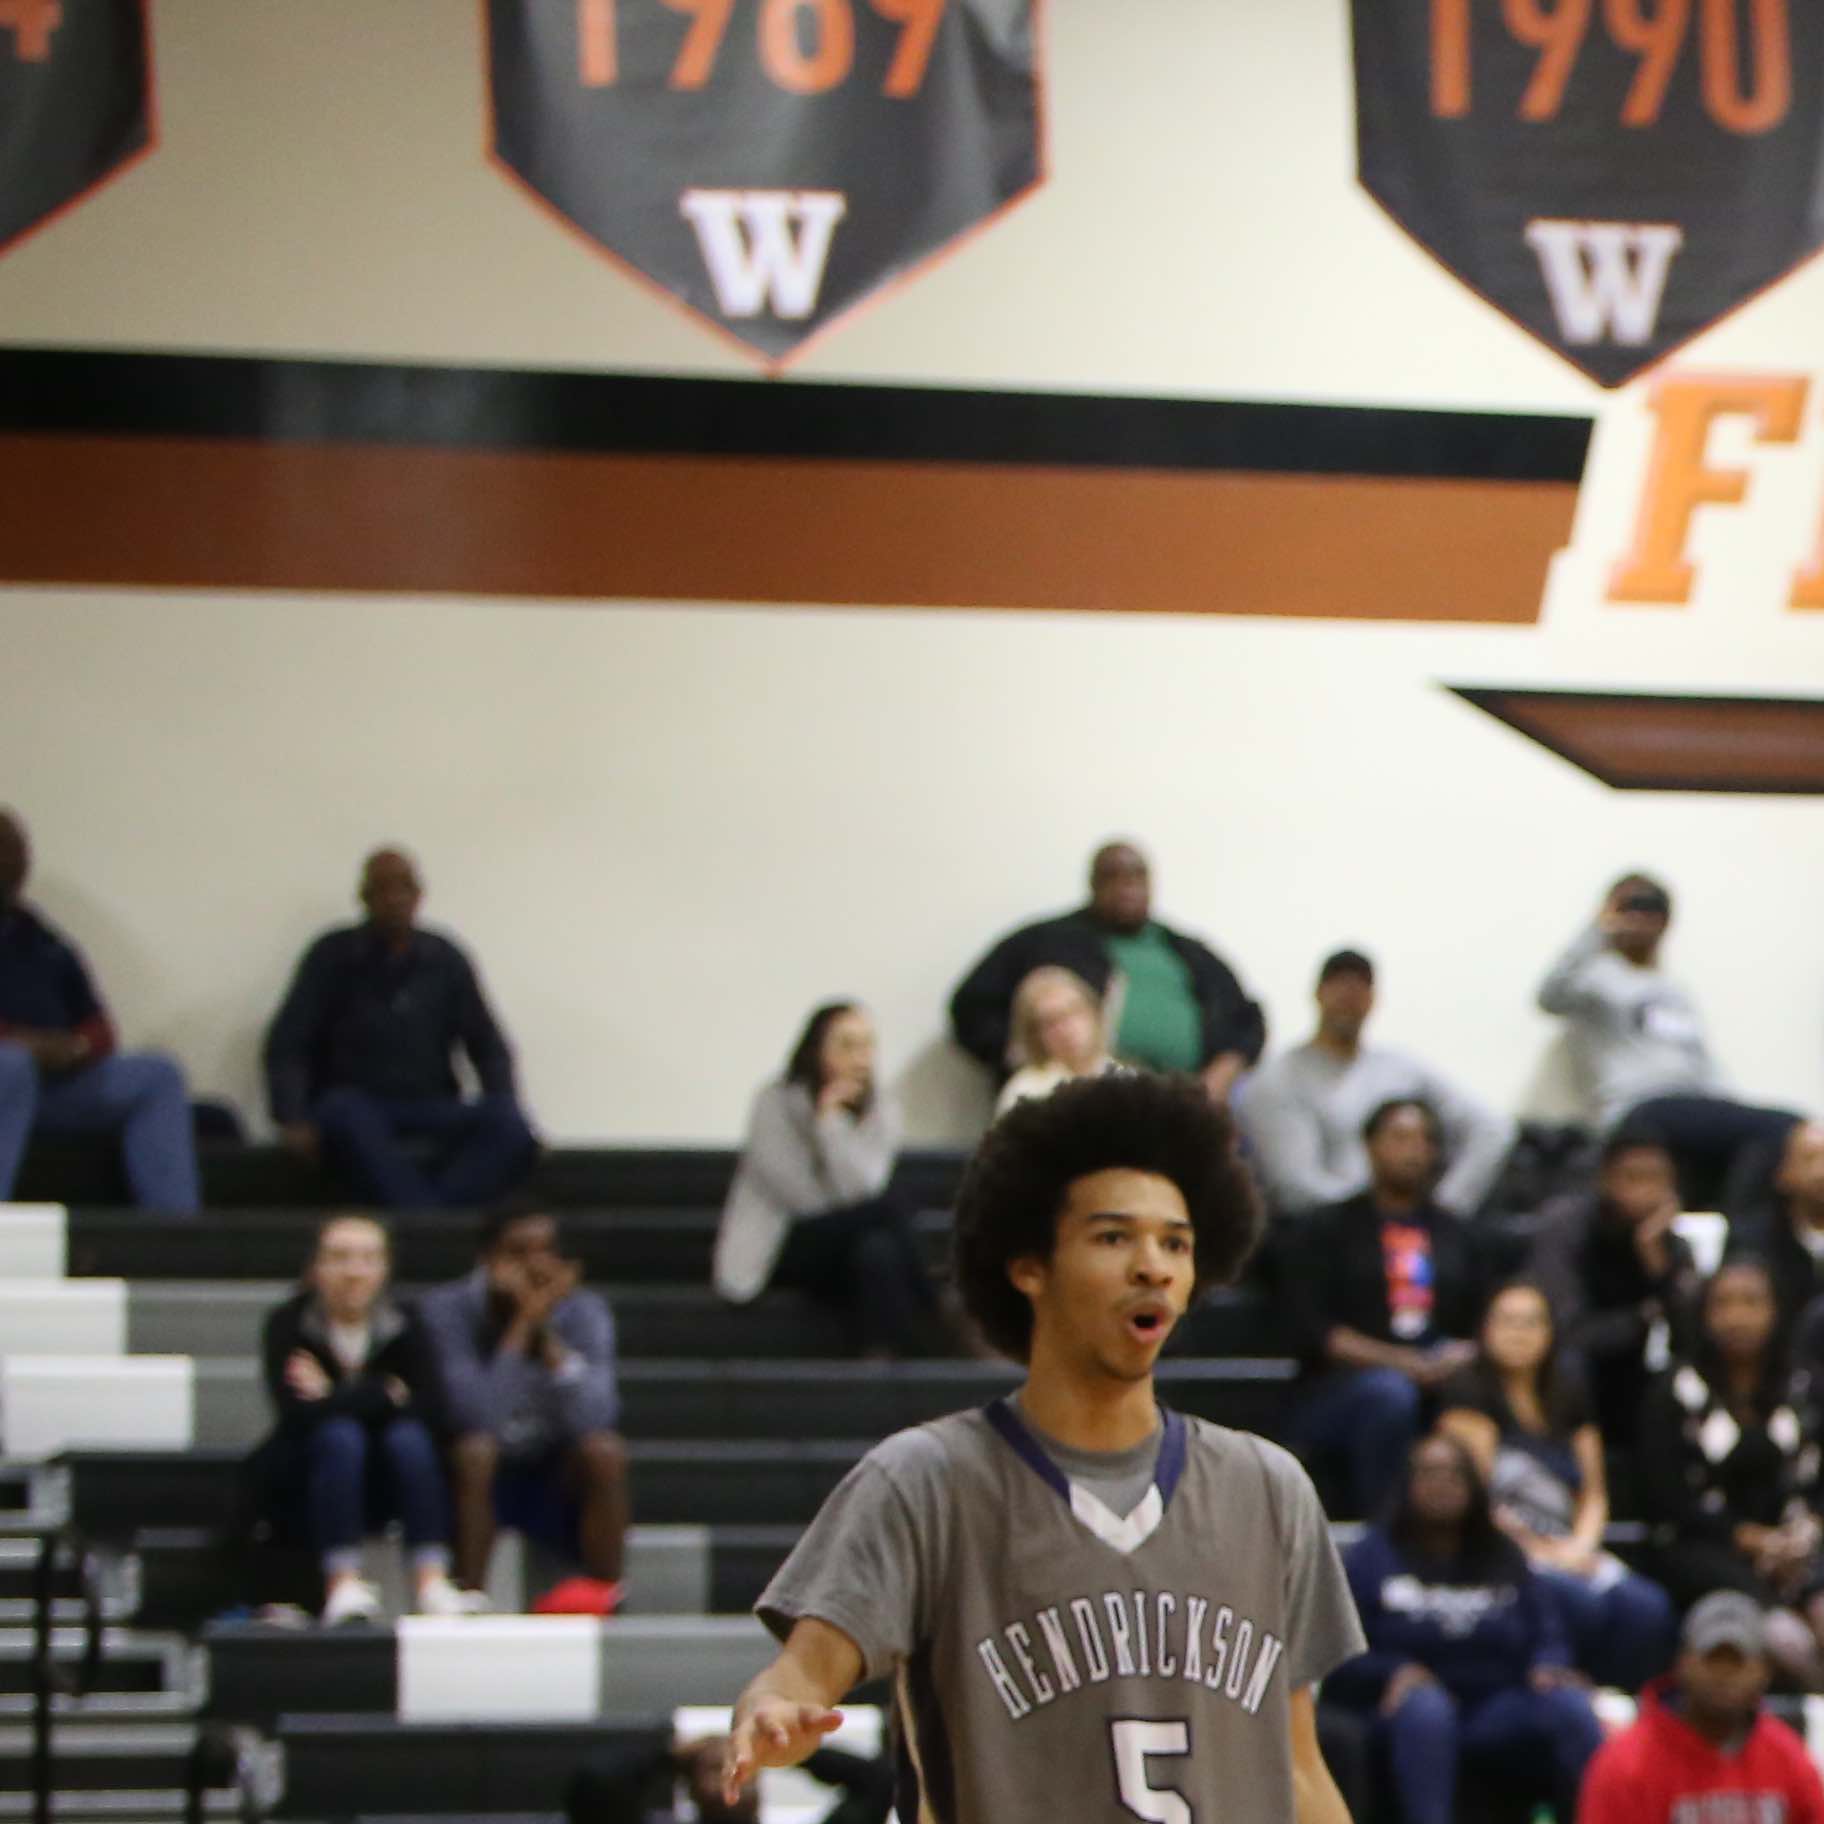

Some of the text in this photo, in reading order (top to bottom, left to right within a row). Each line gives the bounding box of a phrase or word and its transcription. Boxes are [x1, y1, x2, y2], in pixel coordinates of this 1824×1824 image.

[679, 189, 846, 318] W
[1523, 217, 1684, 347] W
[976, 1589, 1283, 1721] HENDRICKSON
